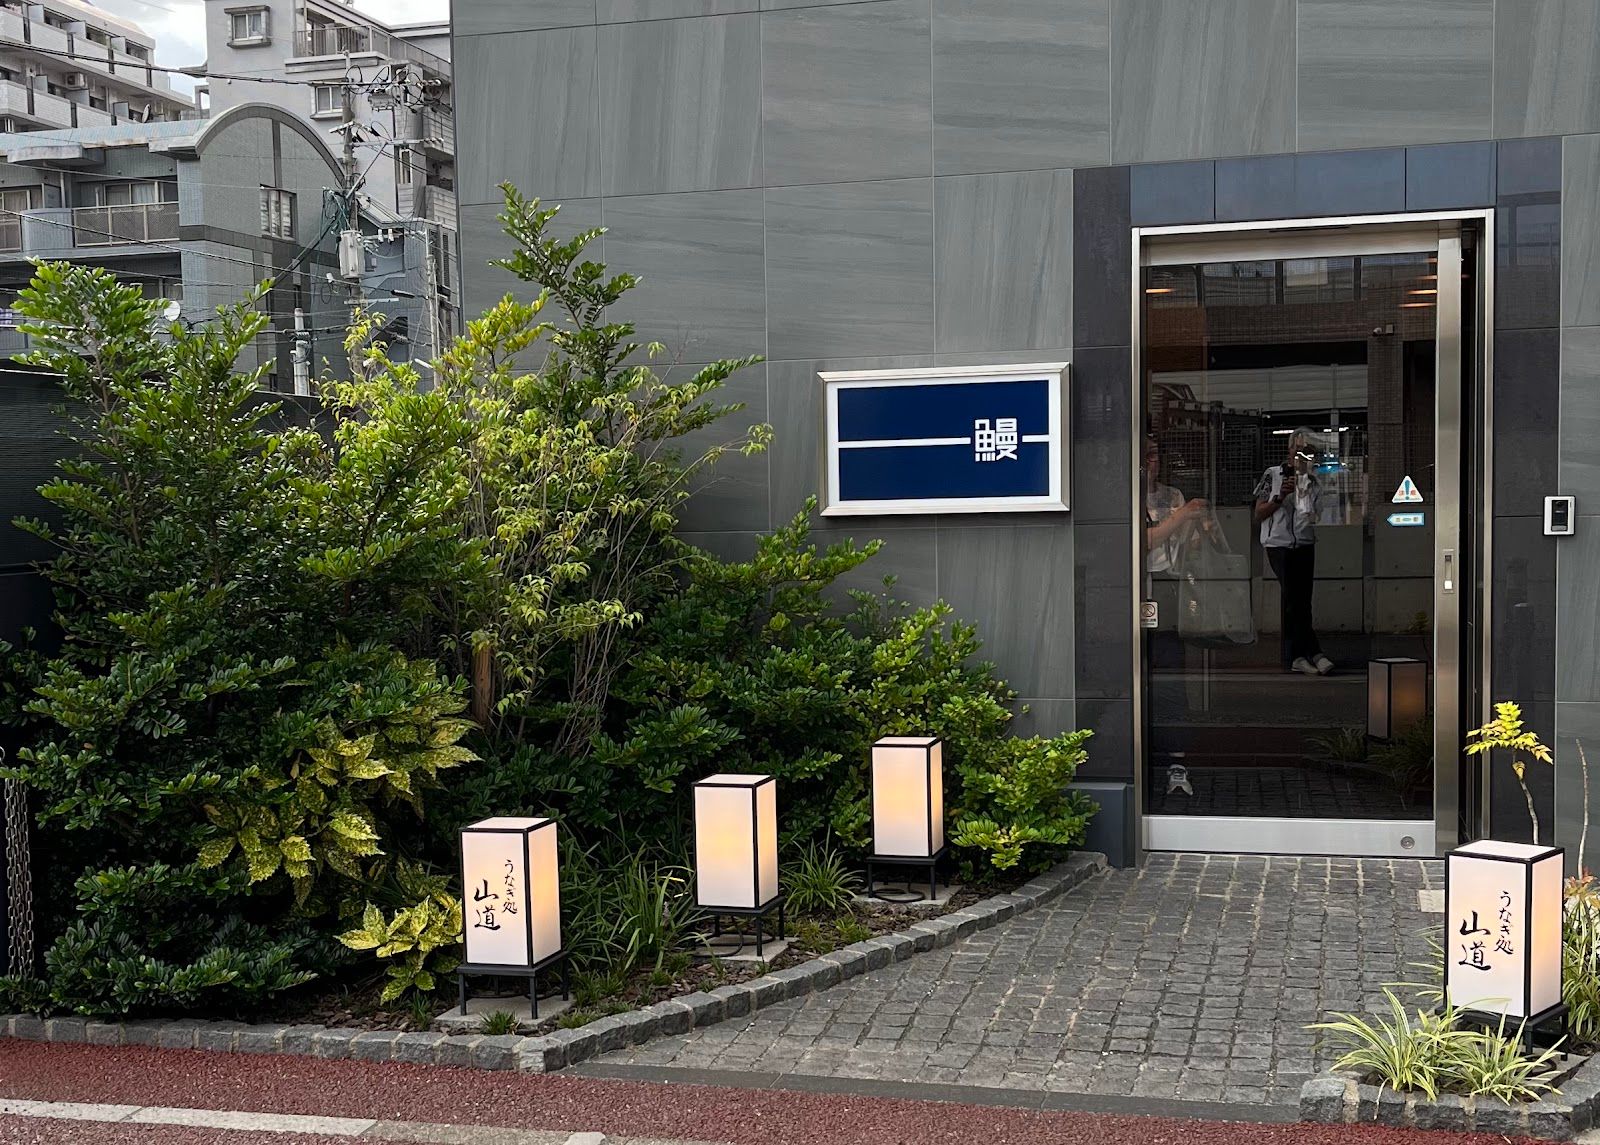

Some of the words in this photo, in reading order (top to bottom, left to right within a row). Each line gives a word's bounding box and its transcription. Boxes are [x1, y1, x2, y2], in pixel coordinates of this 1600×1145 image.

[975, 418, 1018, 461] 鰻
[473, 878, 501, 931] 山道
[502, 859, 518, 915] うなぎ処
[1458, 910, 1492, 971] 山道
[1493, 890, 1514, 955] うなぎ処
